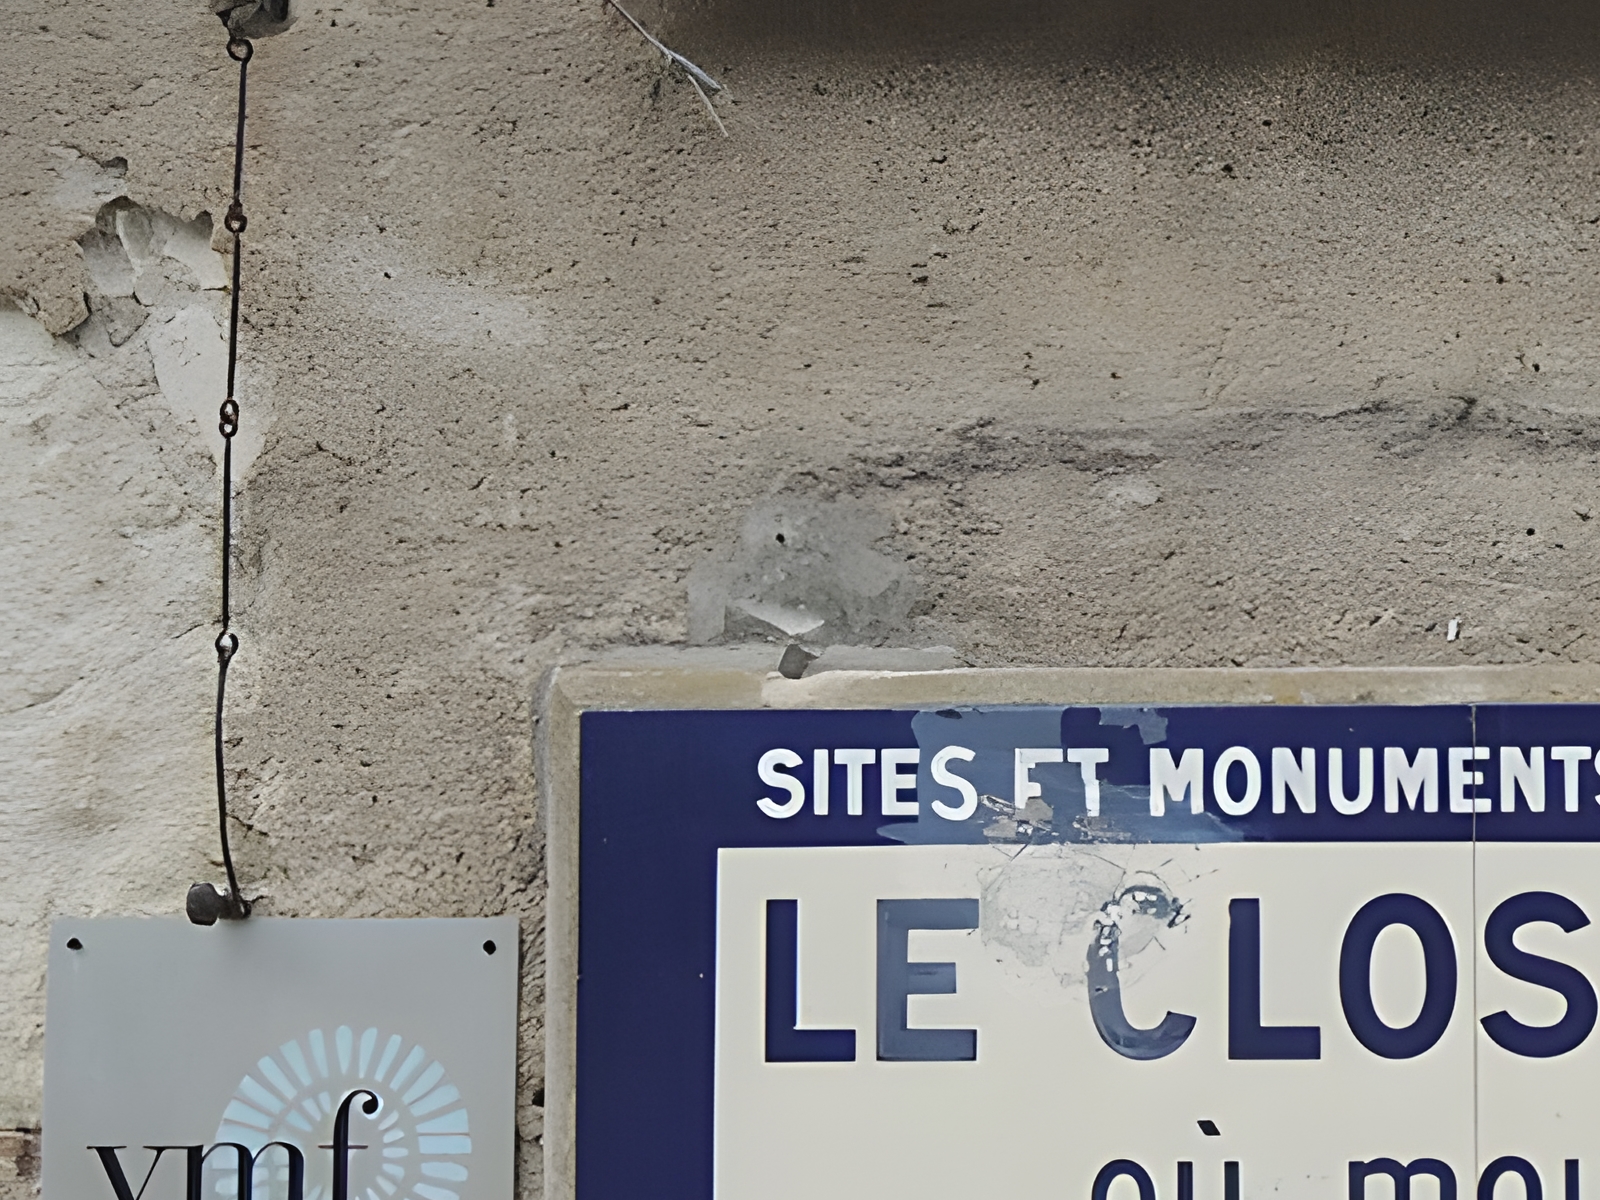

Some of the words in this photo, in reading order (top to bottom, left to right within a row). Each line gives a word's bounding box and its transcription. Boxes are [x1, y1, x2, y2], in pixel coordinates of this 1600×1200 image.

[757, 745, 976, 820] SITES
[765, 898, 980, 1062] LE
[1087, 885, 1599, 1061] CLOS
